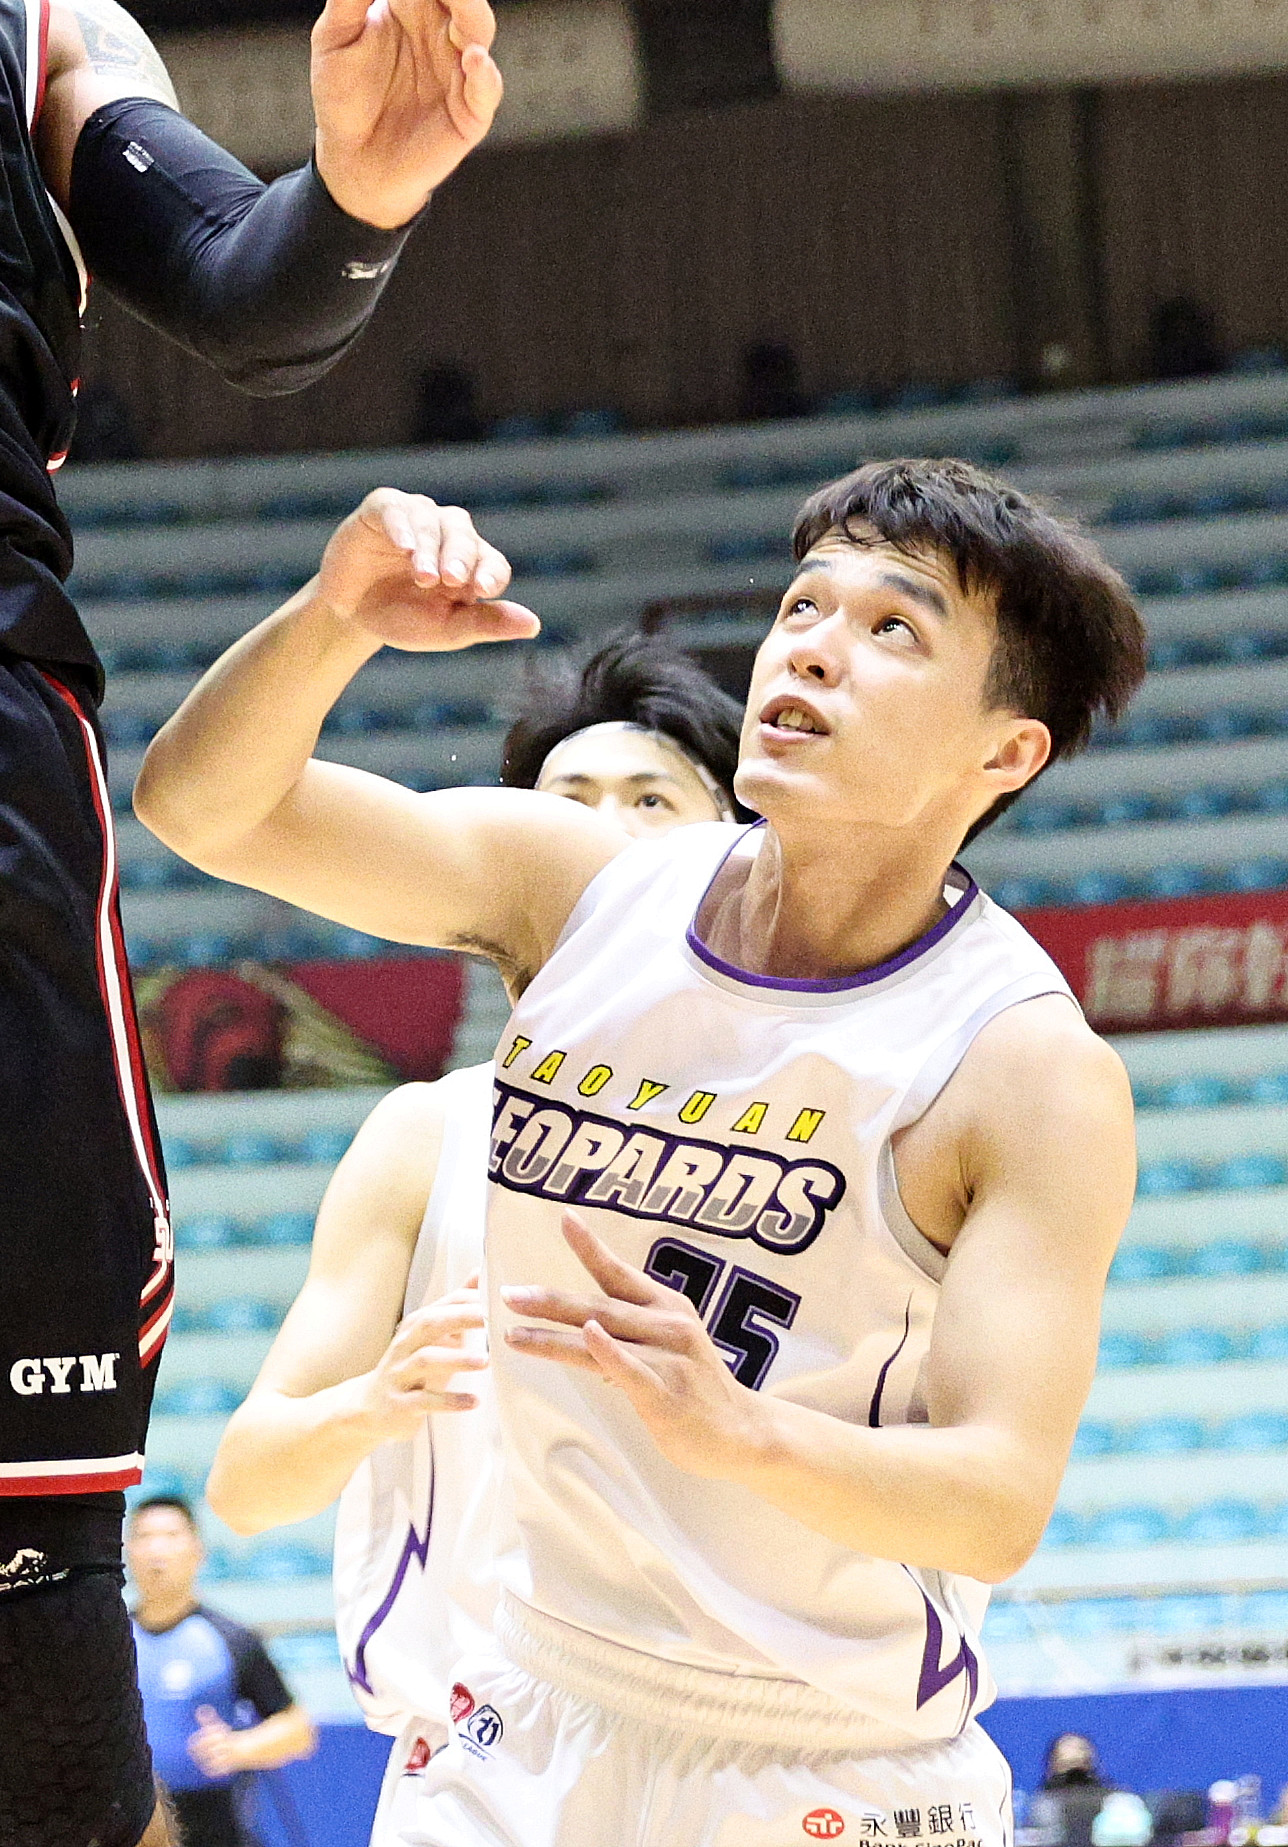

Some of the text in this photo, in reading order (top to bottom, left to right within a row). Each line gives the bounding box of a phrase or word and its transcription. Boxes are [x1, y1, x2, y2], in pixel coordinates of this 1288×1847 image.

[502, 1035, 827, 1144] TAOYUAN
[487, 1078, 847, 1256] EOPARDS
[9, 1352, 119, 1396] GYM
[859, 1802, 976, 1839] 永豐銀行
